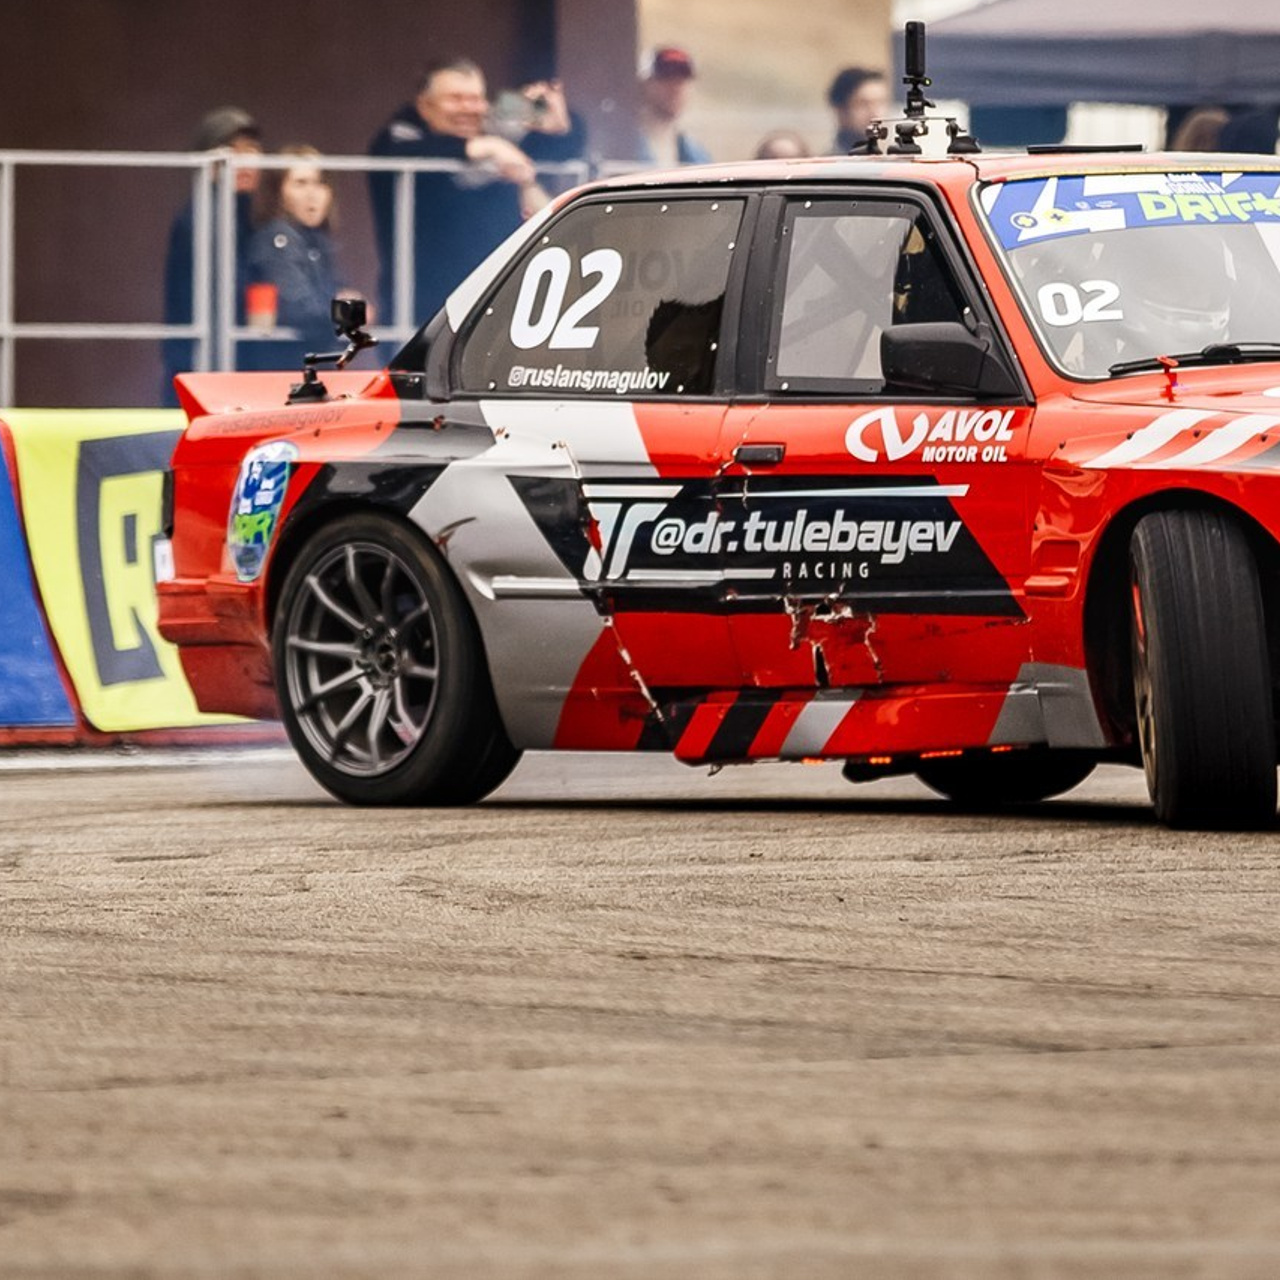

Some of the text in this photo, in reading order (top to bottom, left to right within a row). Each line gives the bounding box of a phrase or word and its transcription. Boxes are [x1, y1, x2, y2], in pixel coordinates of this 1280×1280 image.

[509, 246, 623, 350] 02
[1037, 279, 1124, 326] 02
[927, 410, 1015, 442] AVOL
[922, 446, 1008, 463] MOTOR OIL
[650, 510, 963, 564] @dr.tulebayev
[782, 561, 870, 579] RACING
